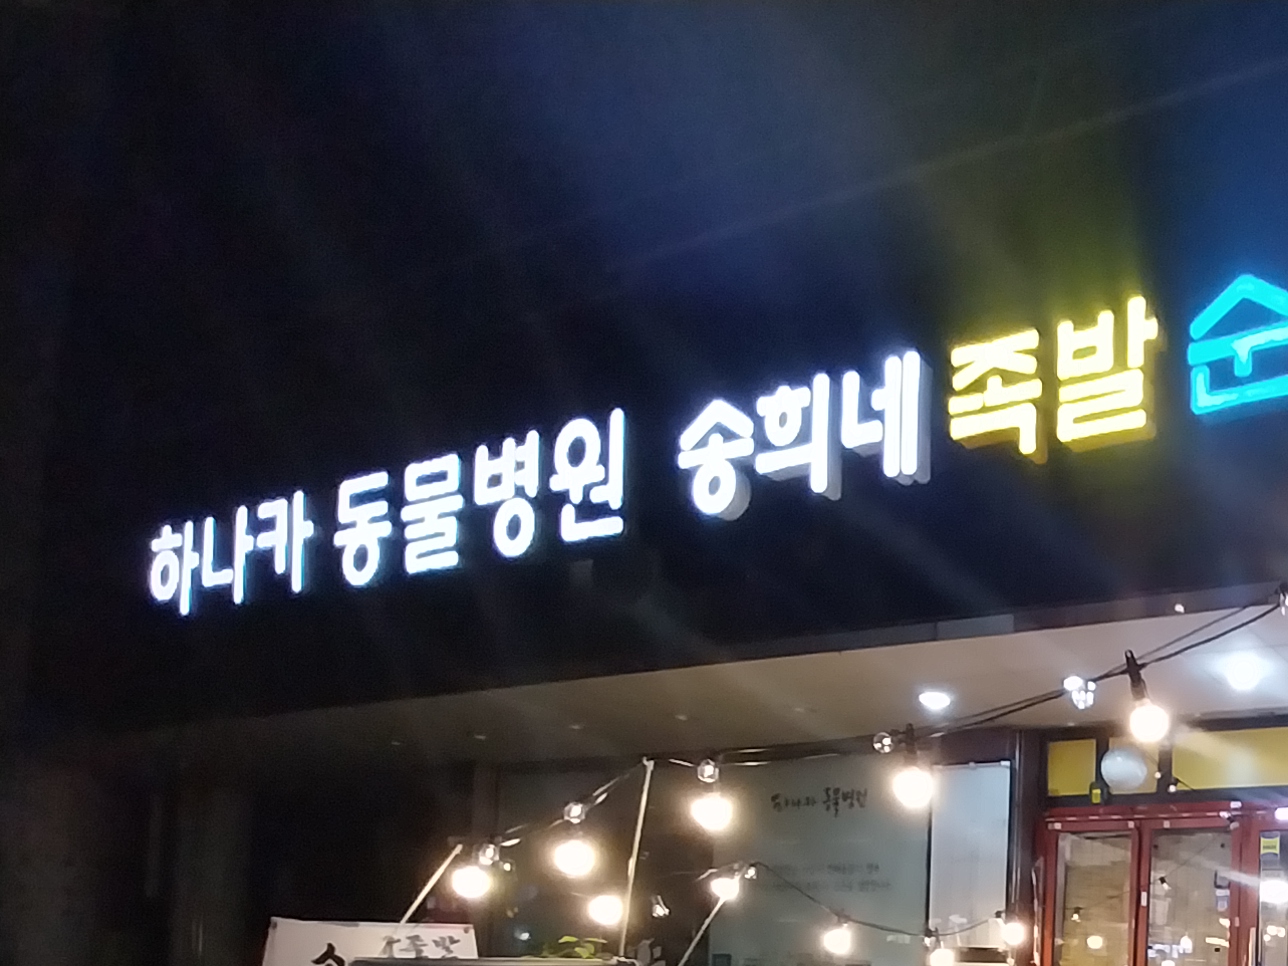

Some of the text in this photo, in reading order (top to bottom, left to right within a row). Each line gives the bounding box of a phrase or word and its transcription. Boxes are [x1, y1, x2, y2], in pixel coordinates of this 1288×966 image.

[148, 407, 628, 617] 하나카 동물병원
[676, 350, 930, 522] 송희네
[948, 293, 1162, 460] 족발
